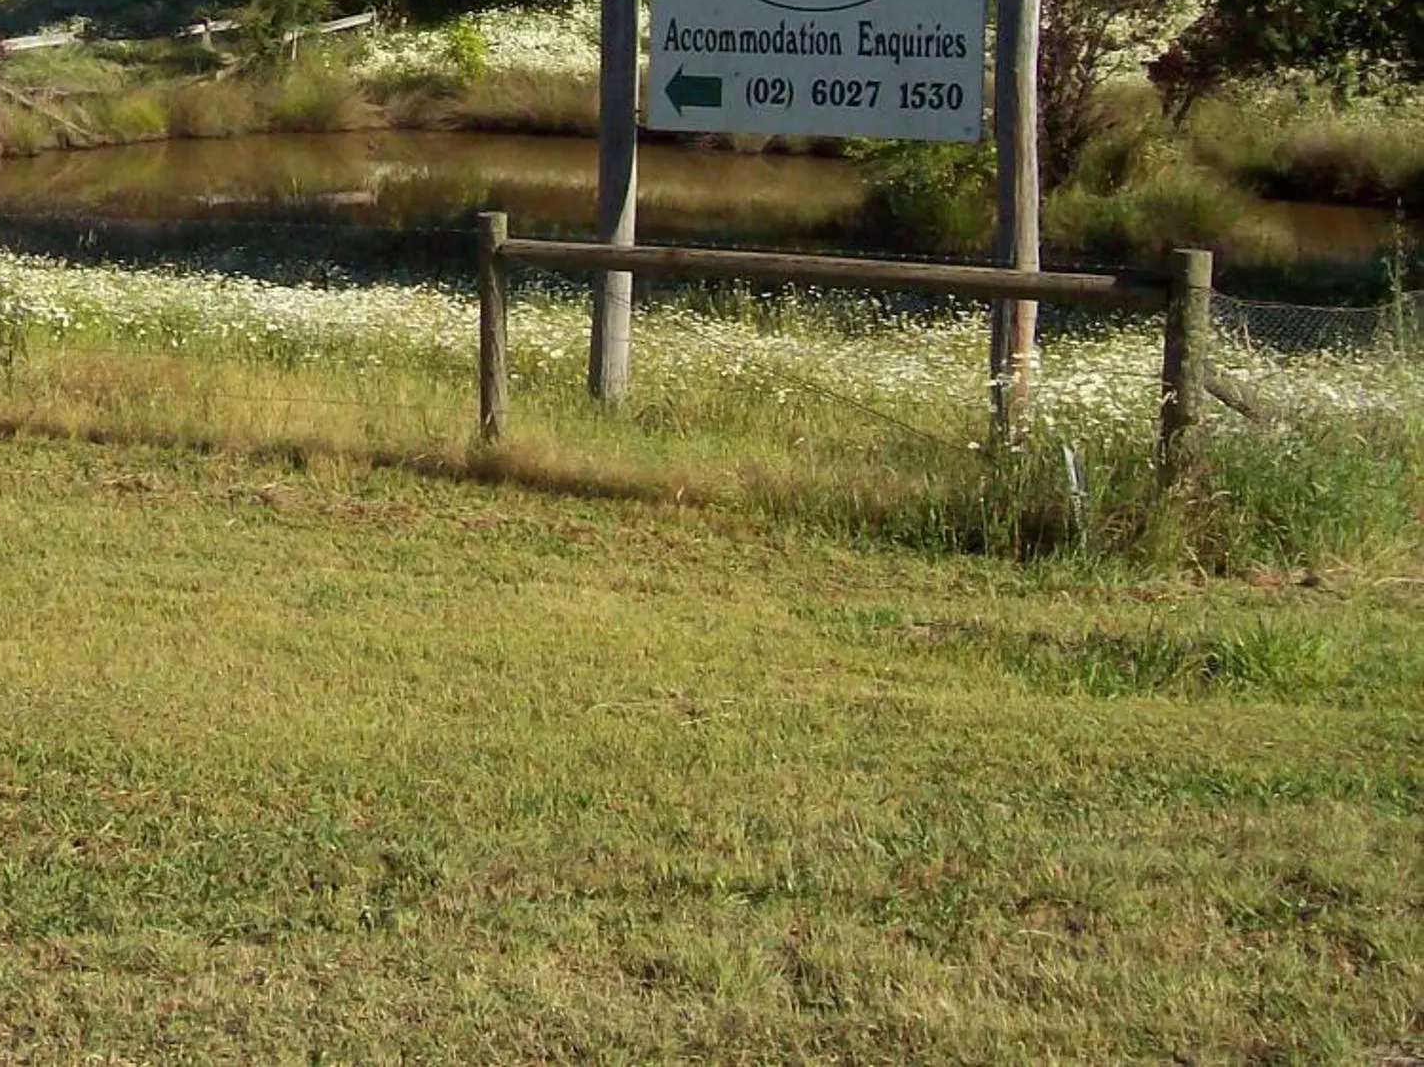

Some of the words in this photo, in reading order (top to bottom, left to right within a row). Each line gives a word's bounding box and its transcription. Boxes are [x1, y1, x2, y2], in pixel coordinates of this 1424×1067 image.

[663, 18, 843, 56] Accommodation
[857, 20, 967, 65] Enquiries
[745, 77, 795, 108] (02)
[811, 79, 883, 109] 6027
[898, 81, 964, 111] 1530
